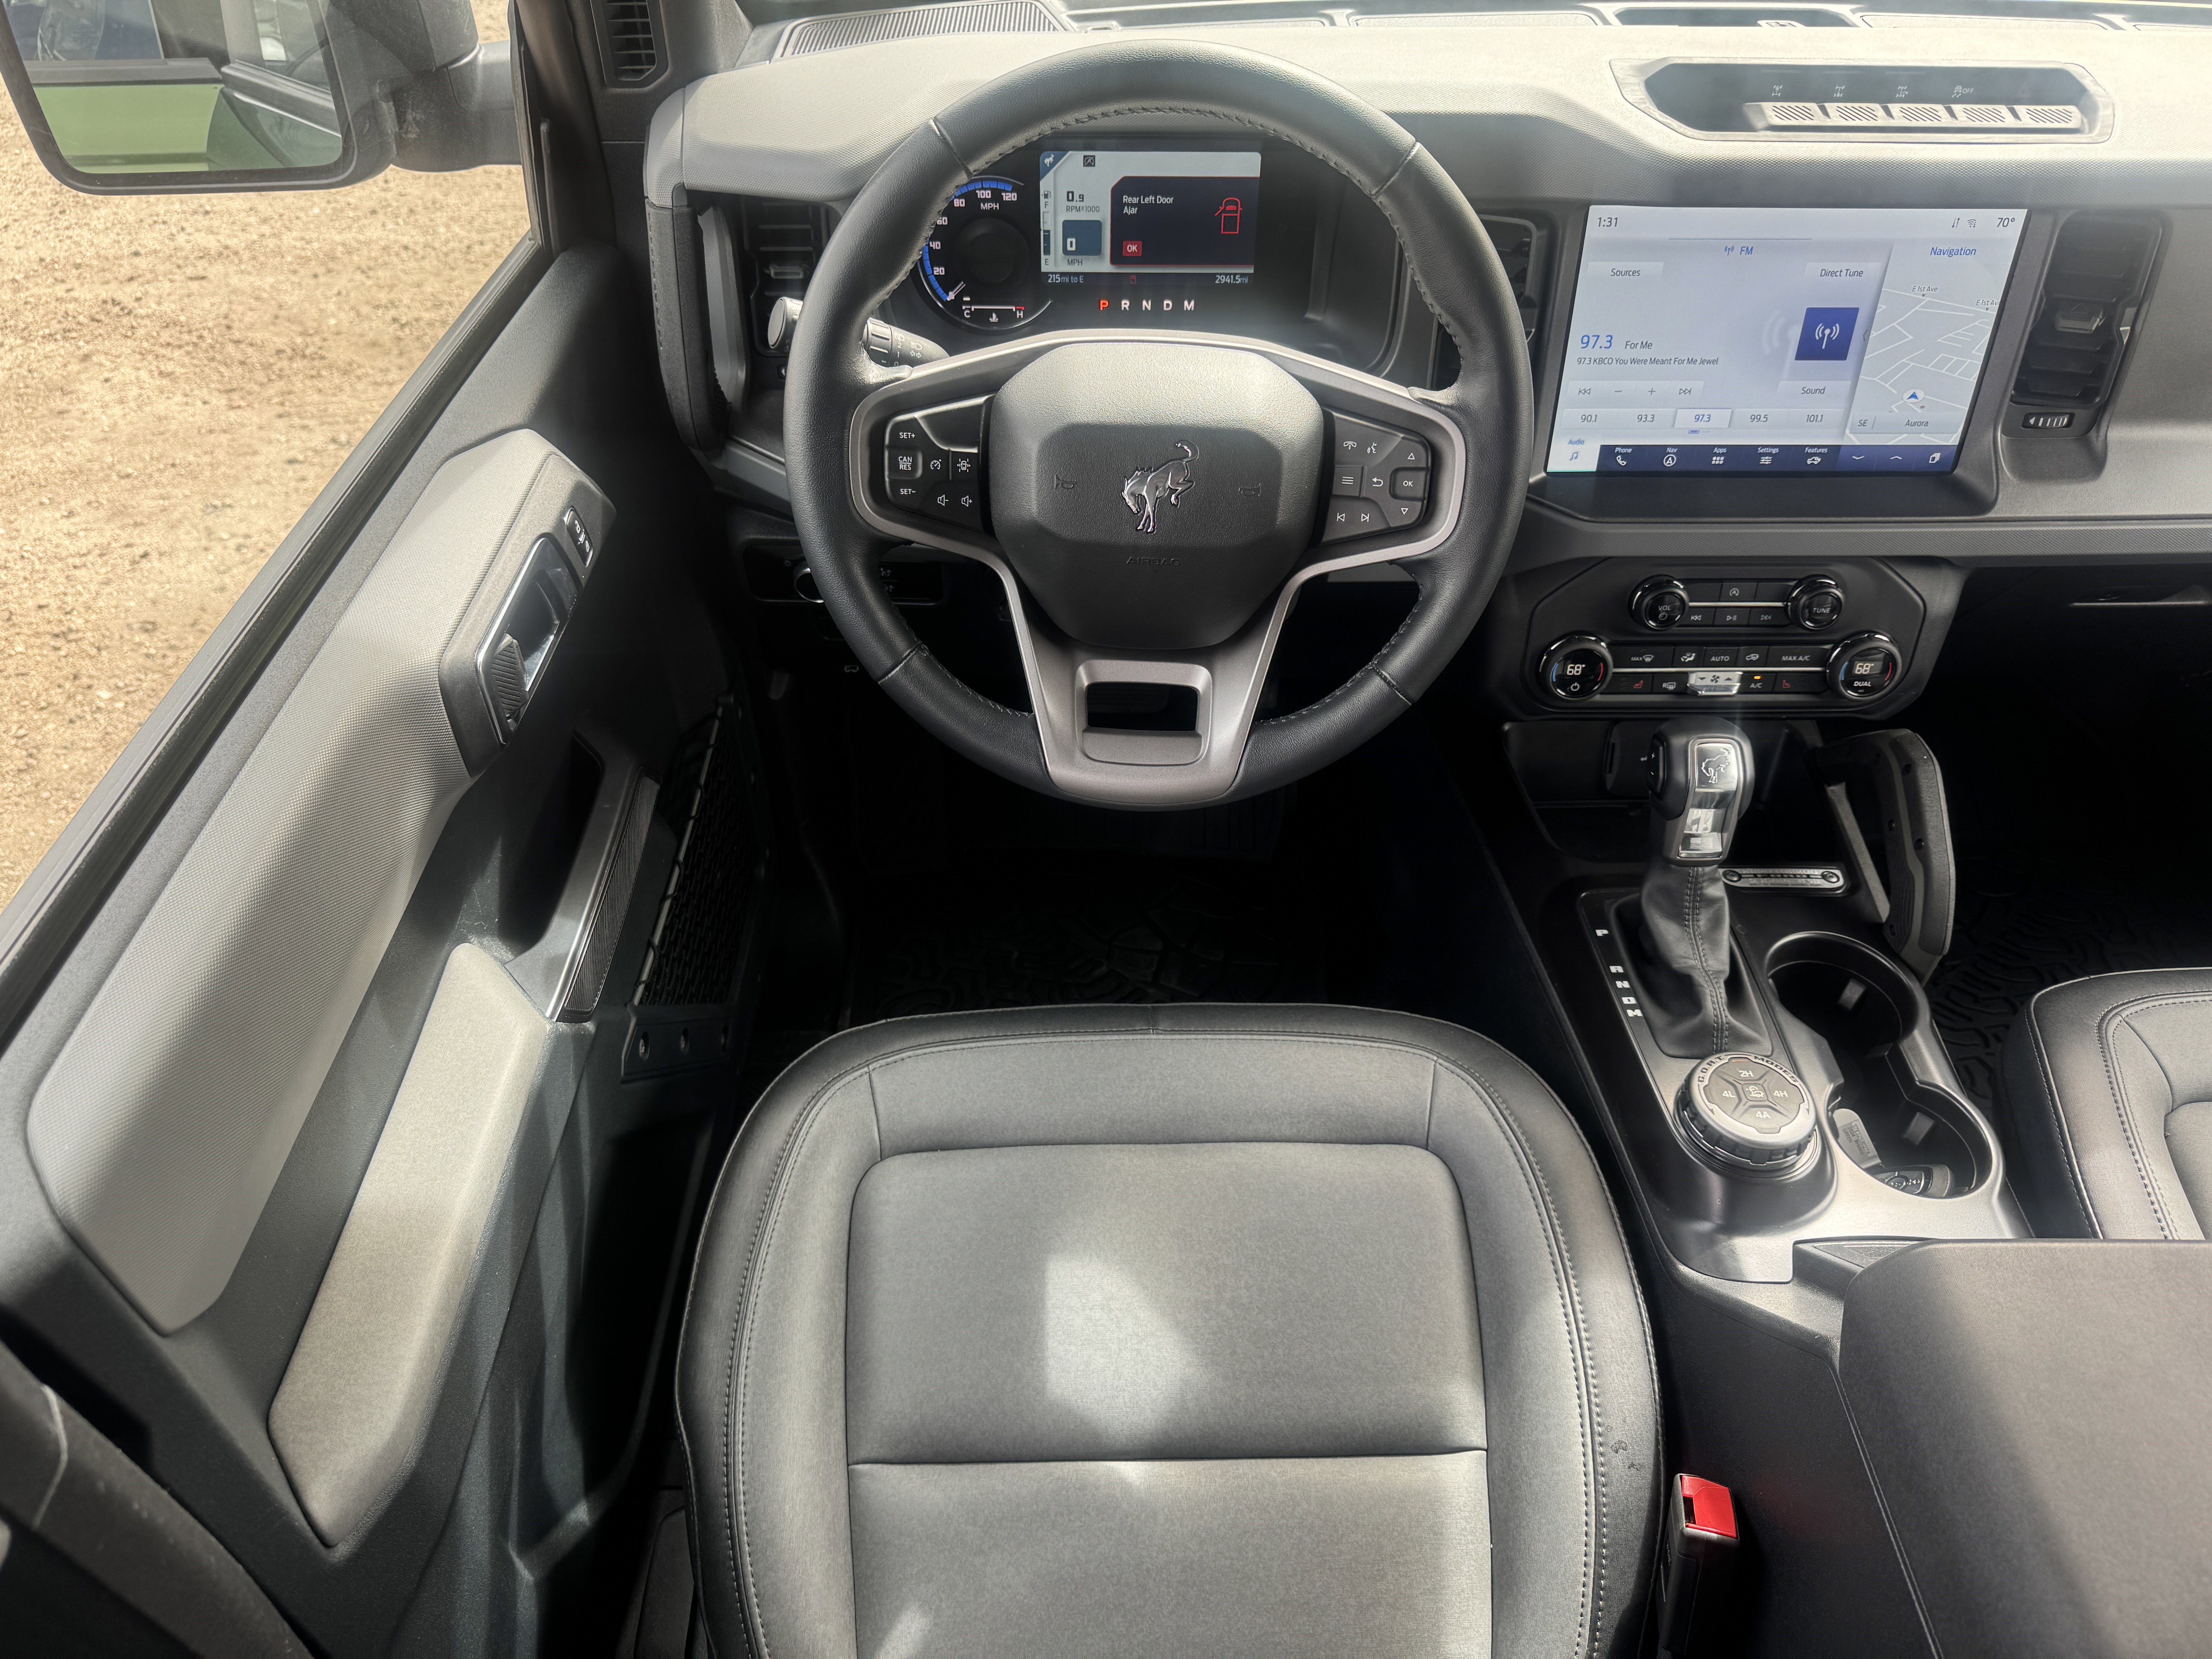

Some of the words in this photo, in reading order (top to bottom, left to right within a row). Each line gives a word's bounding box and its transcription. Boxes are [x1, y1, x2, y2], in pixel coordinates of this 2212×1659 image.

[976, 190, 991, 198] 100
[1001, 193, 1017, 201] 120
[1066, 191, 1084, 202] 0.9
[954, 199, 965, 207] 80
[1123, 196, 1139, 204] Rear
[1141, 196, 1155, 204] Left
[1157, 196, 1174, 204] Door
[1123, 206, 1138, 215] Ajar
[937, 217, 948, 225] 60
[1597, 217, 1618, 227] 1:31
[1997, 217, 2015, 228] 70°
[1067, 238, 1076, 251] 0
[1740, 246, 1753, 256] FM
[1930, 247, 1976, 258] Navigation
[933, 267, 945, 275] 20
[1611, 268, 1640, 277] Sources
[1820, 269, 1843, 277] Direct
[1844, 269, 1863, 277] Tune
[1100, 300, 1109, 310] P
[1121, 299, 1130, 310] R
[1142, 299, 1151, 310] N
[1164, 300, 1172, 310] D
[1184, 300, 1194, 310] M
[1581, 335, 1613, 349] 97.3
[1625, 341, 1639, 349] For
[1640, 341, 1652, 349] Me
[1801, 386, 1826, 395] Sound
[1581, 414, 1597, 422] 90.1
[1637, 414, 1655, 422] 93.3
[1750, 414, 1768, 422] 99.5
[1806, 414, 1823, 422] 101.1
[1126, 556, 1181, 565] AIRBAG
[1753, 1056, 1800, 1083] MODES
